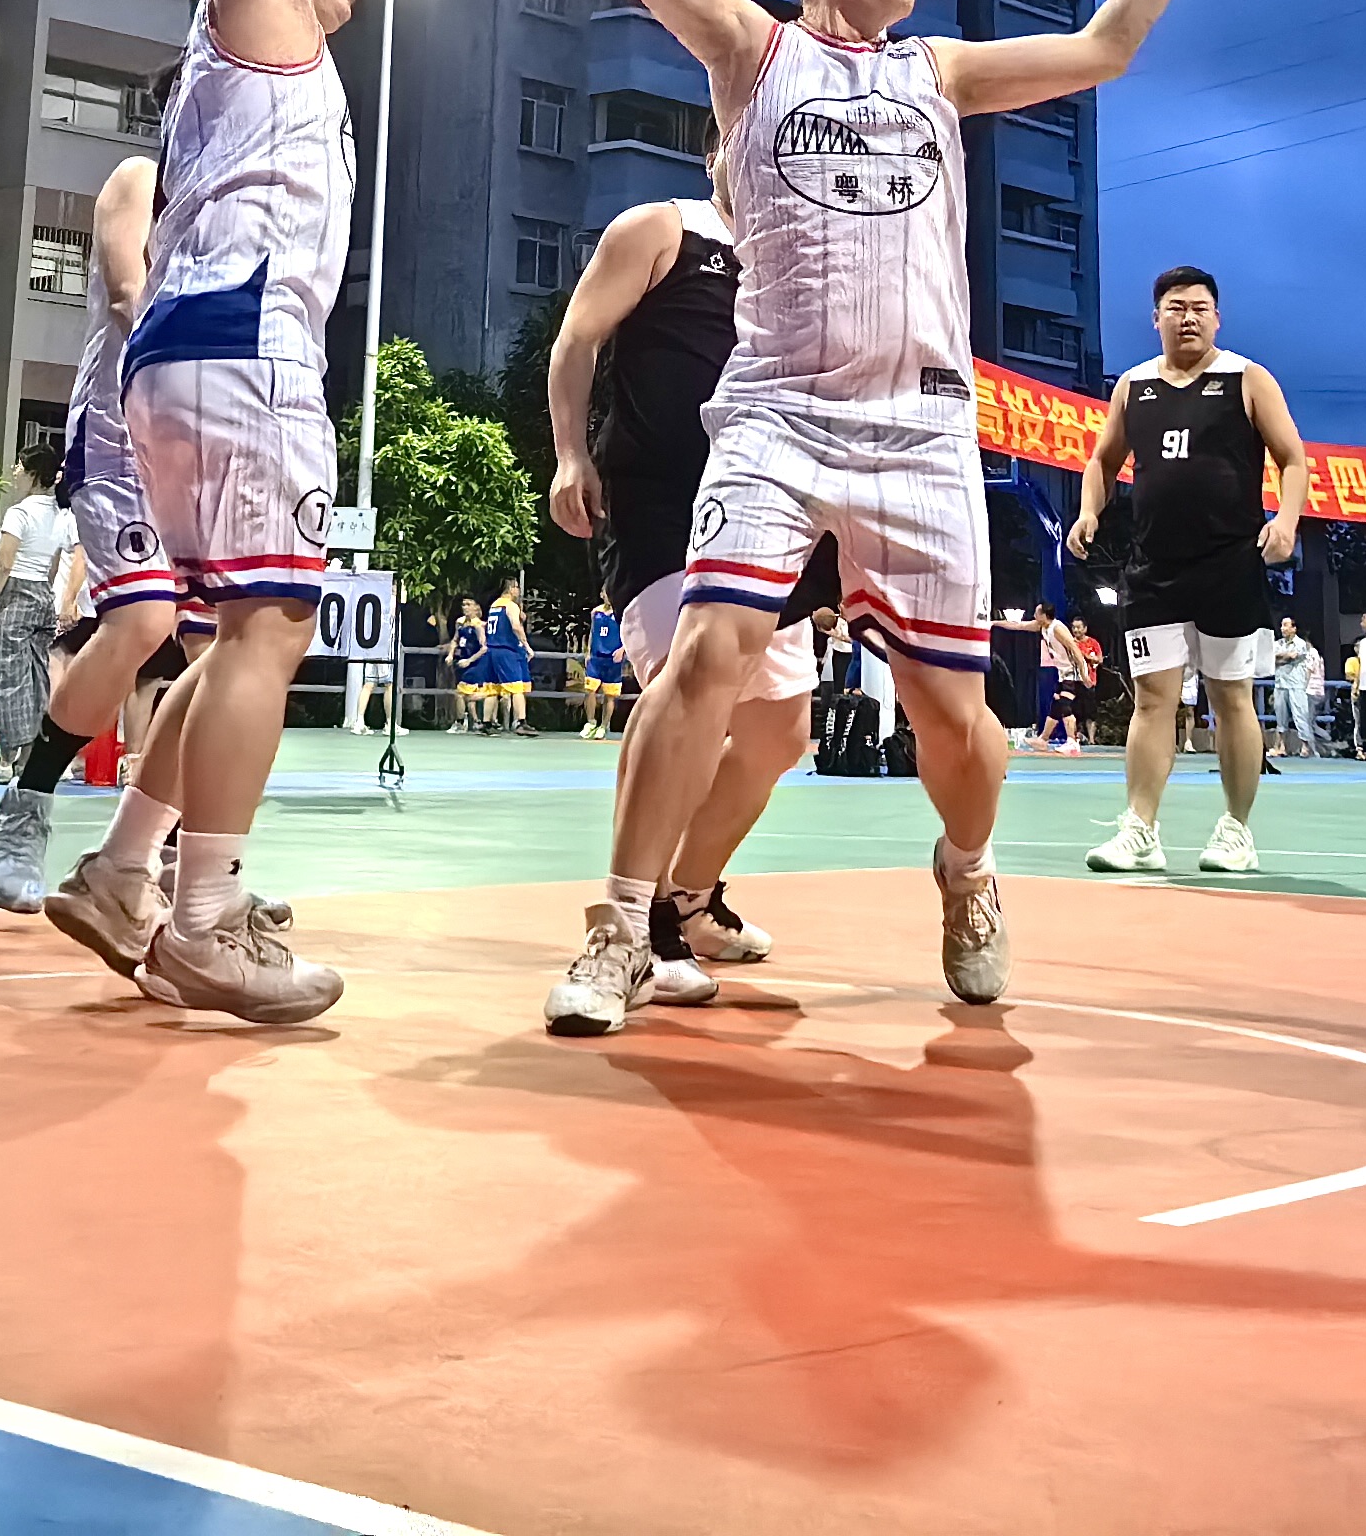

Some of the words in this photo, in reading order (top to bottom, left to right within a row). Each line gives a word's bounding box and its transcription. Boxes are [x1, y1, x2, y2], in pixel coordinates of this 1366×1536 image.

[832, 173, 914, 206] 粤桥
[1161, 428, 1190, 459] 91
[316, 503, 326, 531] 7
[1131, 636, 1150, 658] 91
